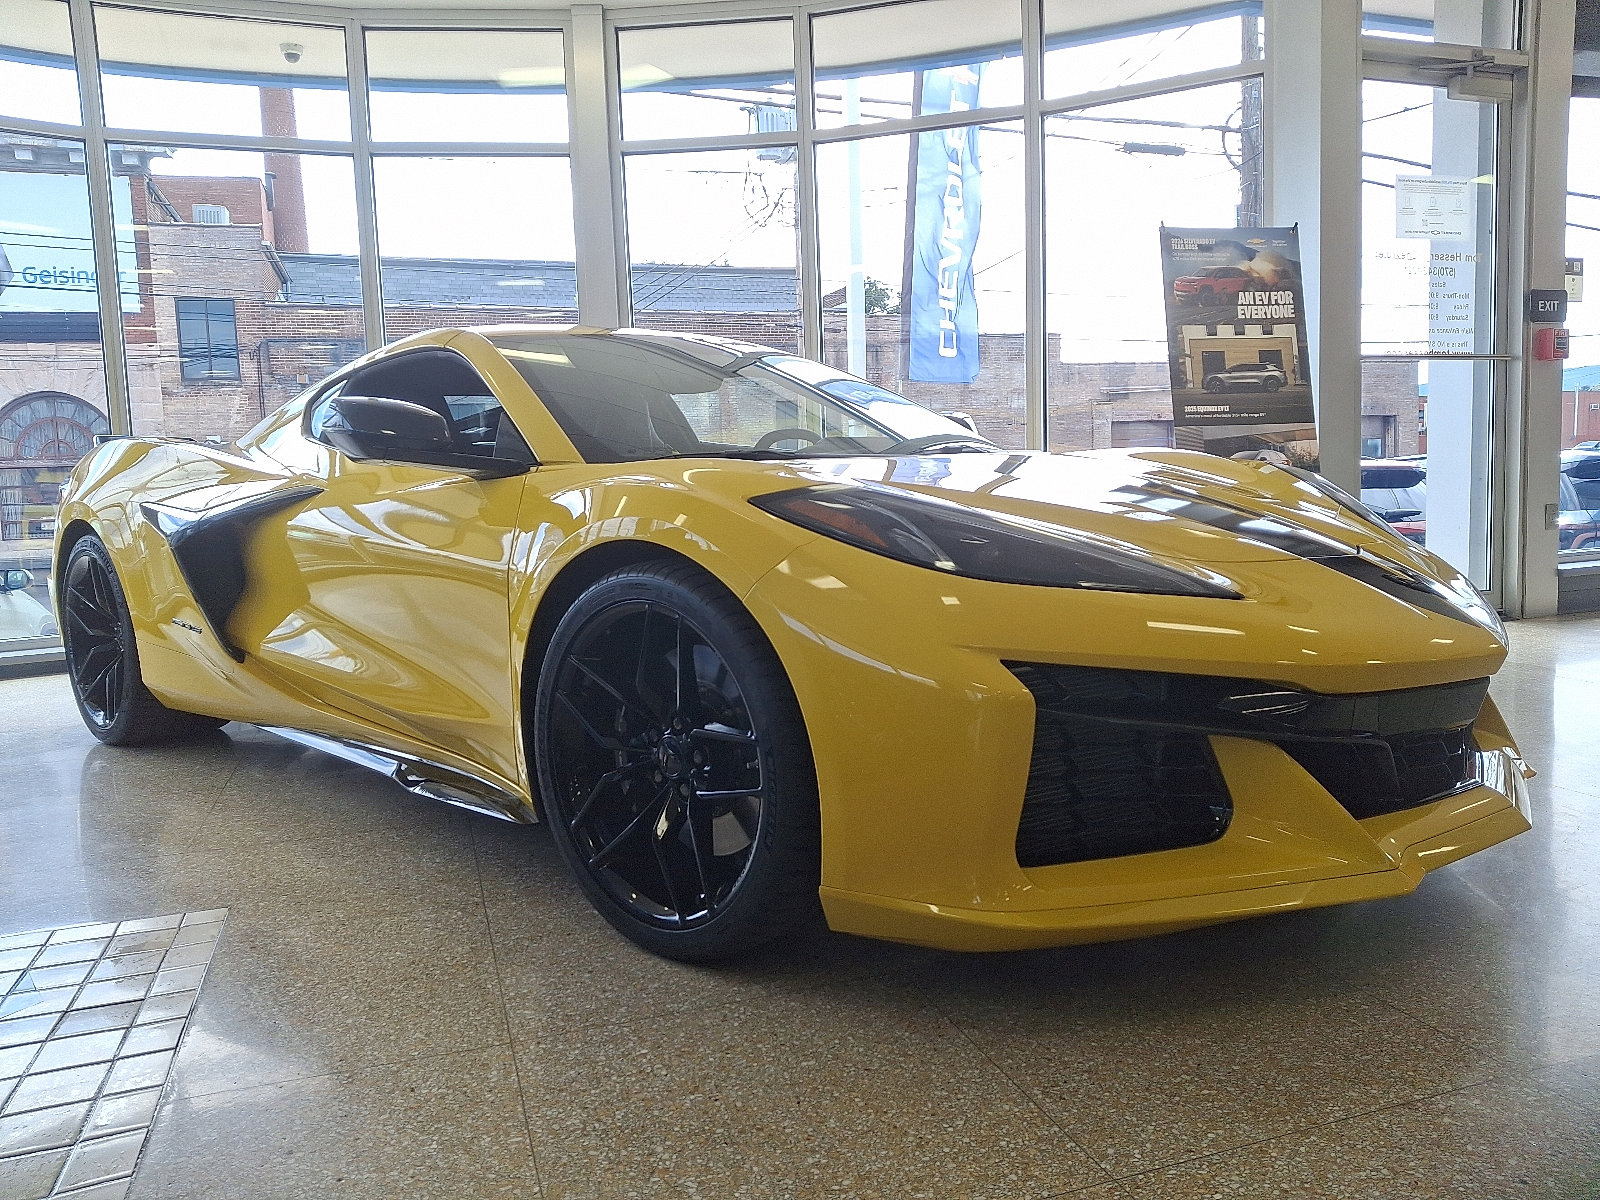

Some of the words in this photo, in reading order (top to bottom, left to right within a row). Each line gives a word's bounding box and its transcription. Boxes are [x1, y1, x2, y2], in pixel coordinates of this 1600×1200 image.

[937, 89, 971, 358] CHEVROLET
[1238, 291, 1254, 305] AN
[1255, 291, 1270, 305] EV
[1271, 290, 1294, 305] FOR
[1237, 304, 1296, 319] EVERYONE
[1538, 300, 1560, 312] EXIT
